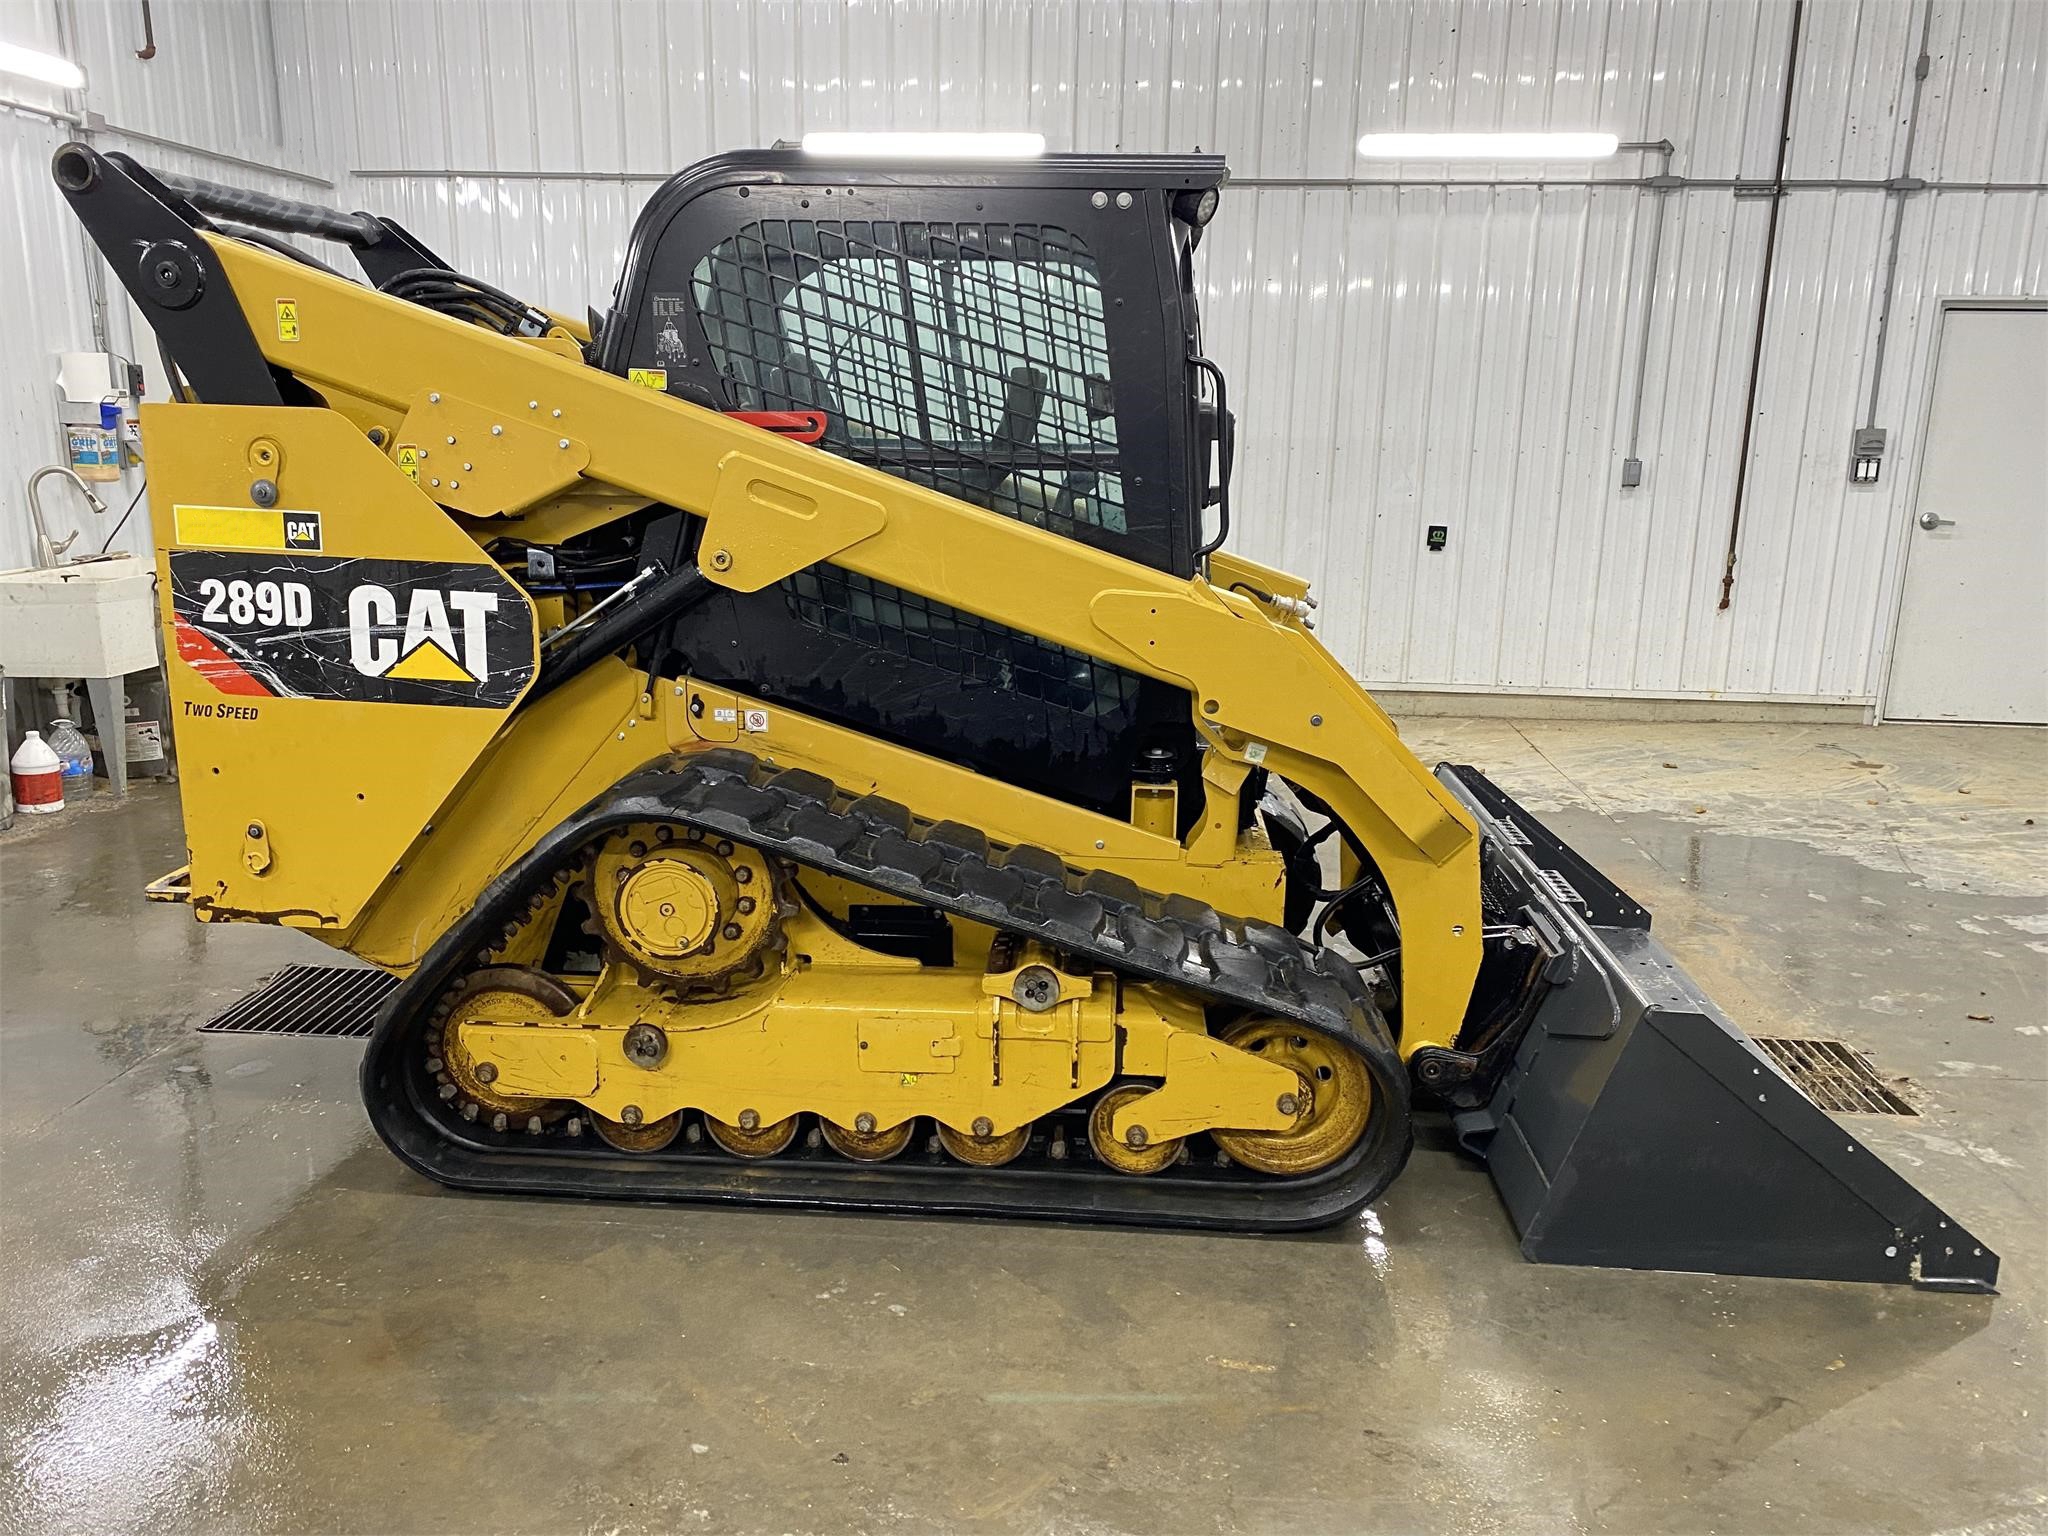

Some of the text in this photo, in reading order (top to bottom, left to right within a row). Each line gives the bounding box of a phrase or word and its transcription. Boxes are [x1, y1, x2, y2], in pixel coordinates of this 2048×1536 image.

[71, 438, 97, 448] GRIP
[286, 521, 317, 541] CAT
[199, 578, 313, 627] 289D
[348, 584, 499, 683] CAT
